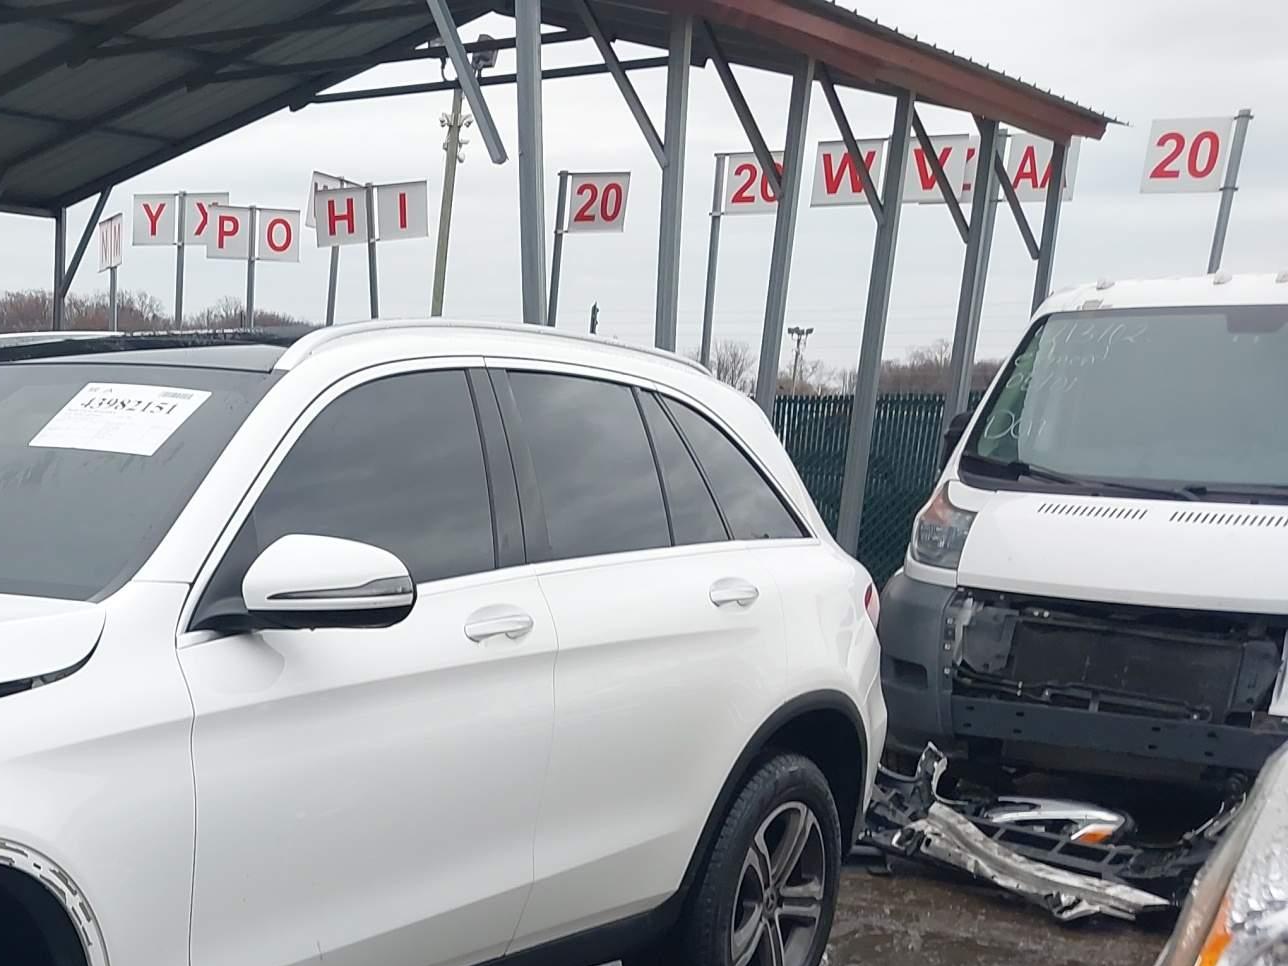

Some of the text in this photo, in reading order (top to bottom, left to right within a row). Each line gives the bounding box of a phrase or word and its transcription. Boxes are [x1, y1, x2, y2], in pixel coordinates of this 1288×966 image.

[822, 150, 877, 194] W
[913, 147, 953, 190] V
[1149, 131, 1220, 179] 20
[142, 203, 166, 236] Y
[327, 192, 407, 236] H I
[573, 182, 623, 223] 20
[217, 215, 292, 252] P O
